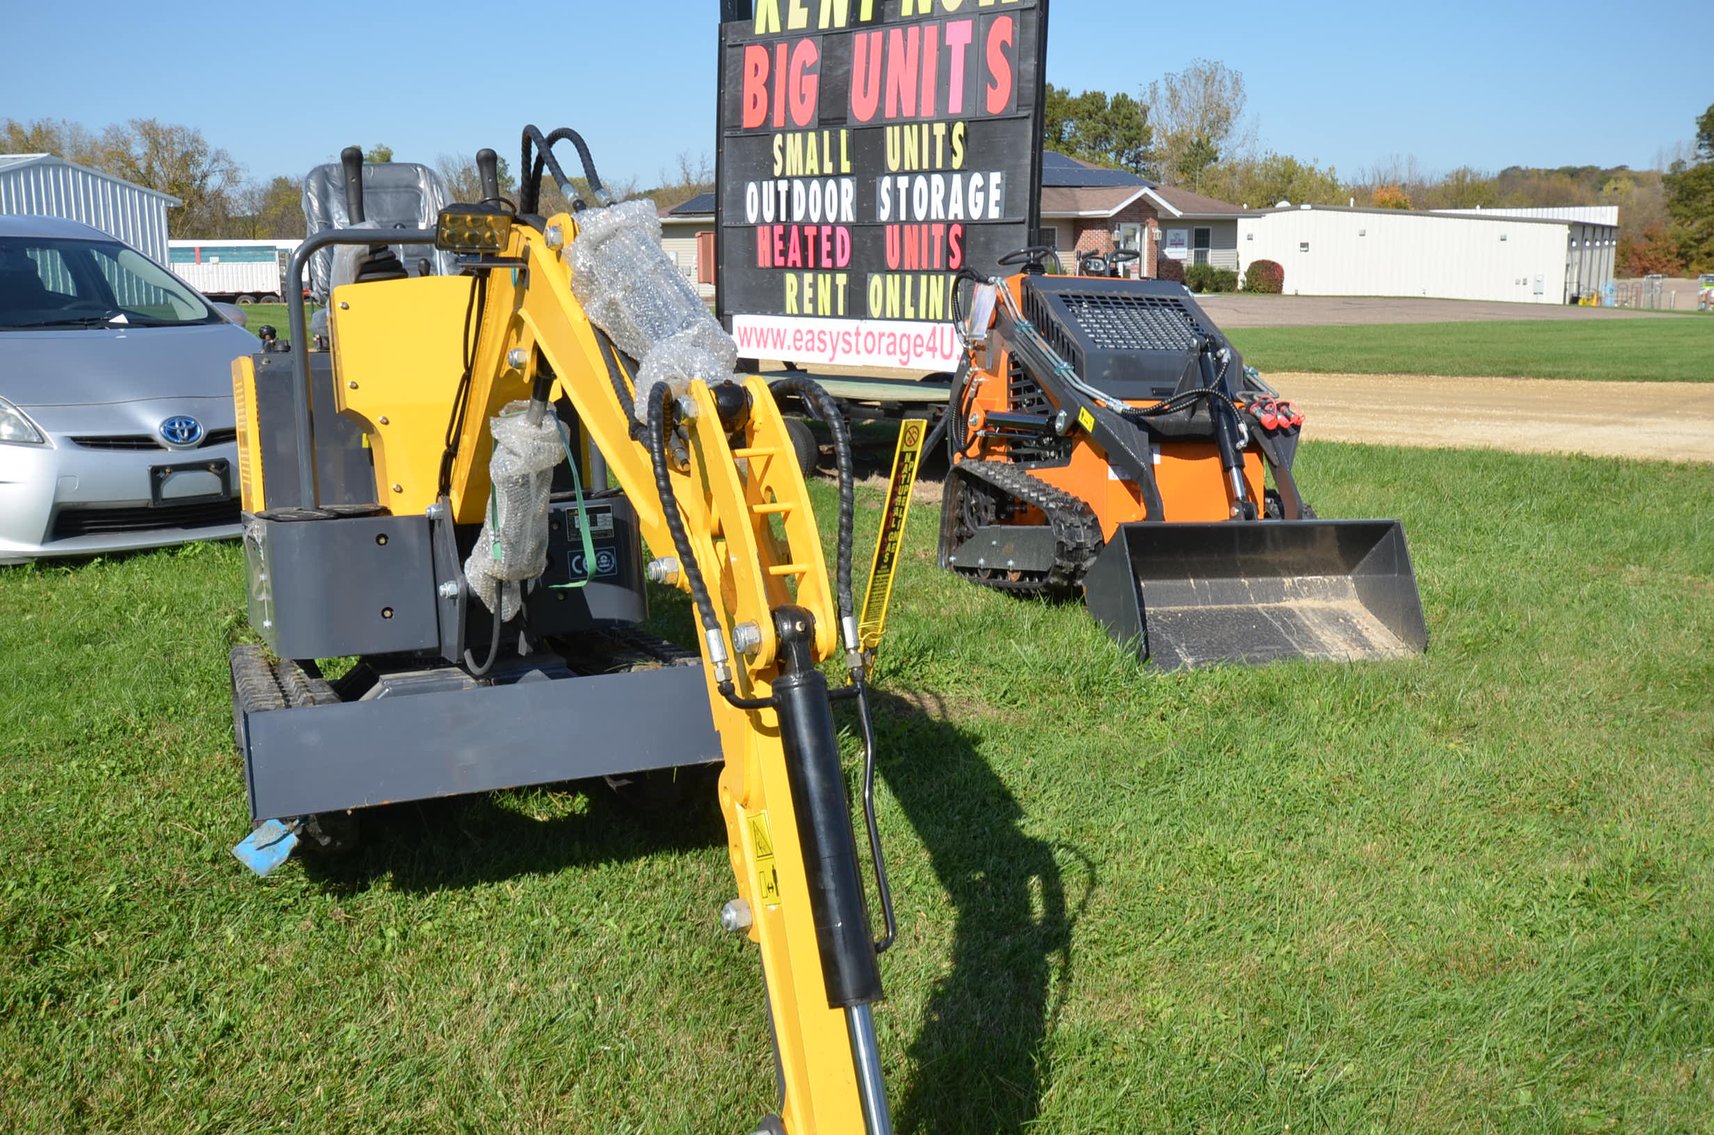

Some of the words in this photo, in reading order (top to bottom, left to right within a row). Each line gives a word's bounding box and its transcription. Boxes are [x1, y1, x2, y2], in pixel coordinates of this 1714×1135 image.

[742, 38, 819, 129] BIG
[851, 15, 1014, 122] UNITS
[773, 128, 851, 177] SMALL
[886, 121, 966, 172] UNITS
[745, 177, 854, 224] OUTDOOR
[880, 171, 1002, 222] STORAGE
[757, 224, 851, 269] HEATED
[885, 223, 964, 270] UNITS
[785, 272, 847, 316] RENT
